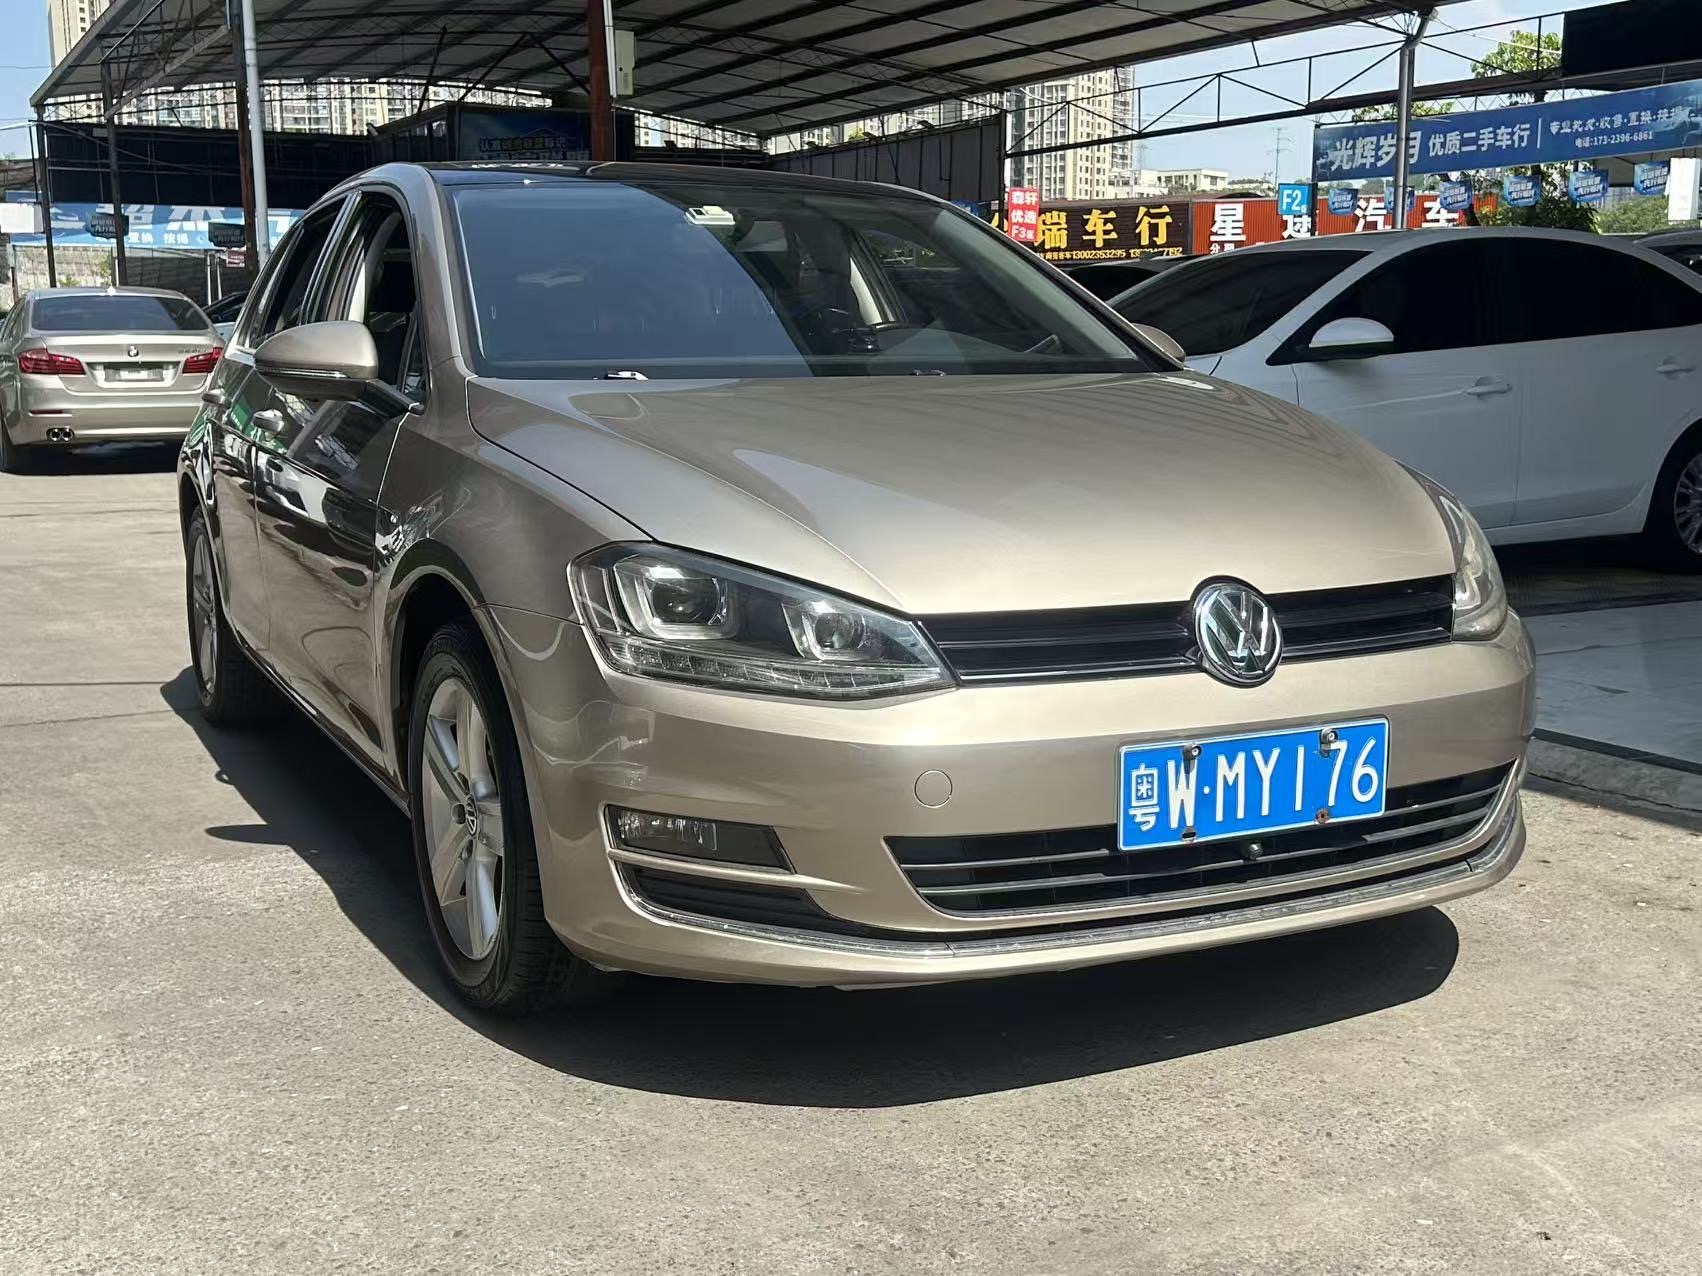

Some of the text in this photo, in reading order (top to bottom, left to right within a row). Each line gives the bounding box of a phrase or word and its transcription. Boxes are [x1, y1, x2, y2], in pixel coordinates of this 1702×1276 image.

[1428, 123, 1531, 157] 优质二手车行
[1011, 209, 1037, 224] 优选
